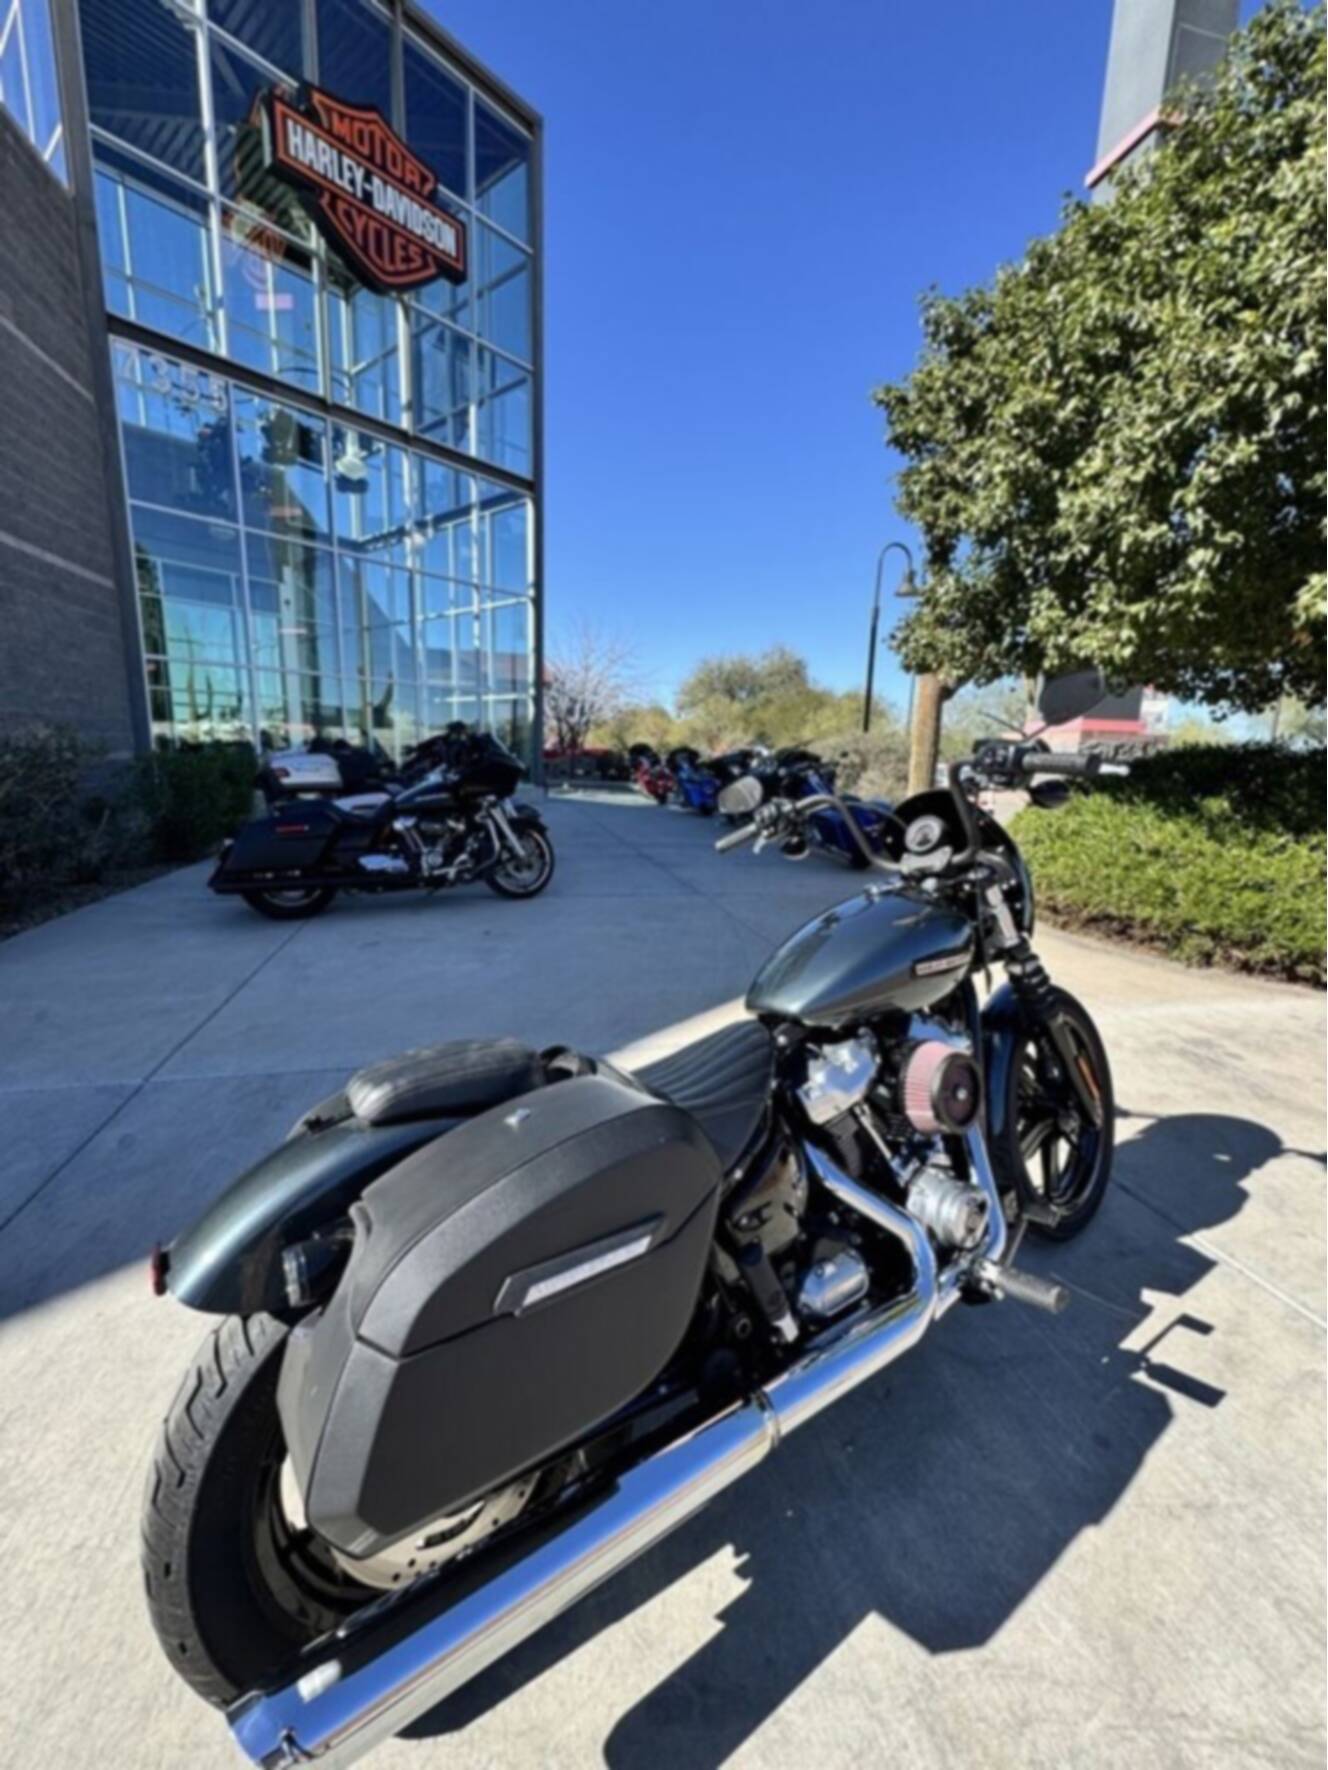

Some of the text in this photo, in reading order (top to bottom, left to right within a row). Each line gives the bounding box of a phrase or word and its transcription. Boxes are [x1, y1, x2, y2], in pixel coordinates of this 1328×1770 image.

[286, 117, 457, 259] HARLEY-DAVIDSON
[331, 110, 421, 191] MOTOR
[335, 200, 422, 272] CYCLES
